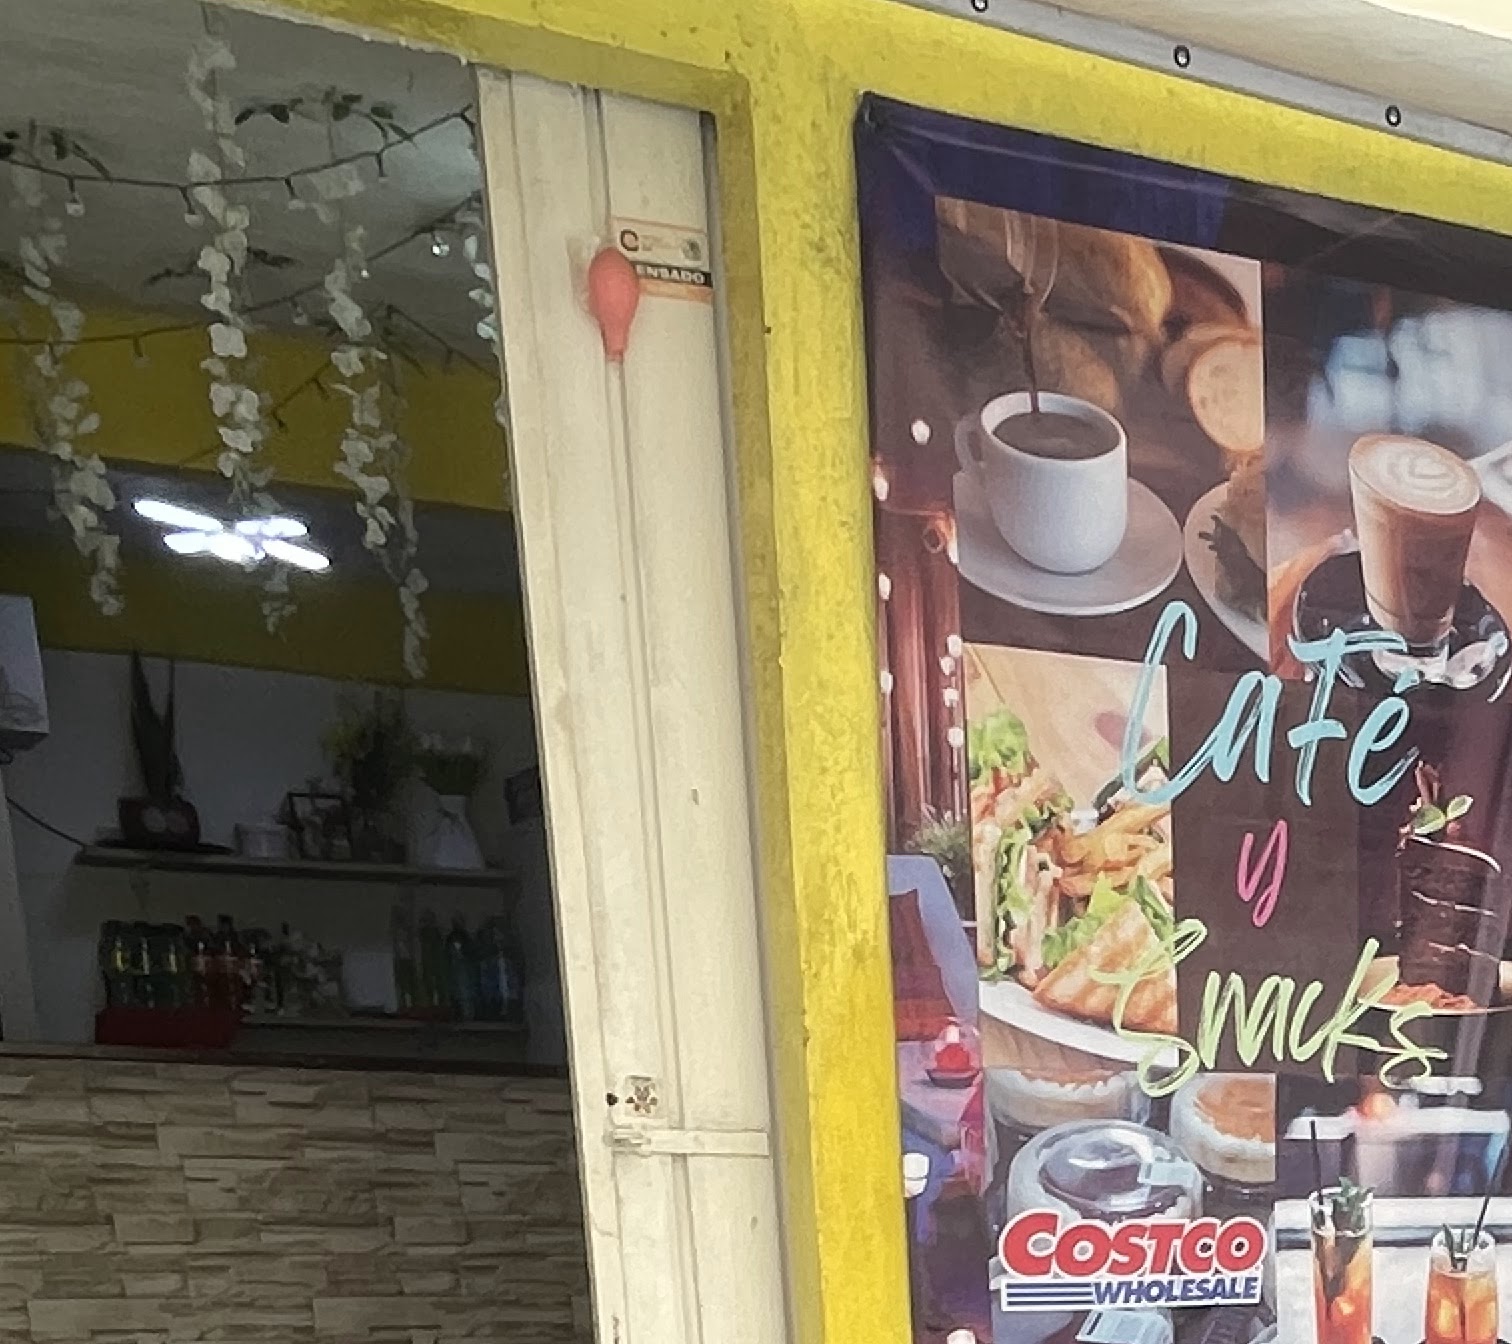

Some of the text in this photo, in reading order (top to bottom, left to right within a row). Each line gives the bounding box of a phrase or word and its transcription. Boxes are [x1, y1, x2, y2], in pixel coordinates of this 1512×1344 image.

[635, 265, 705, 285] ENSADO
[1002, 1212, 1265, 1277] COSTCO
[1092, 1276, 1259, 1304] WHOLESALE
